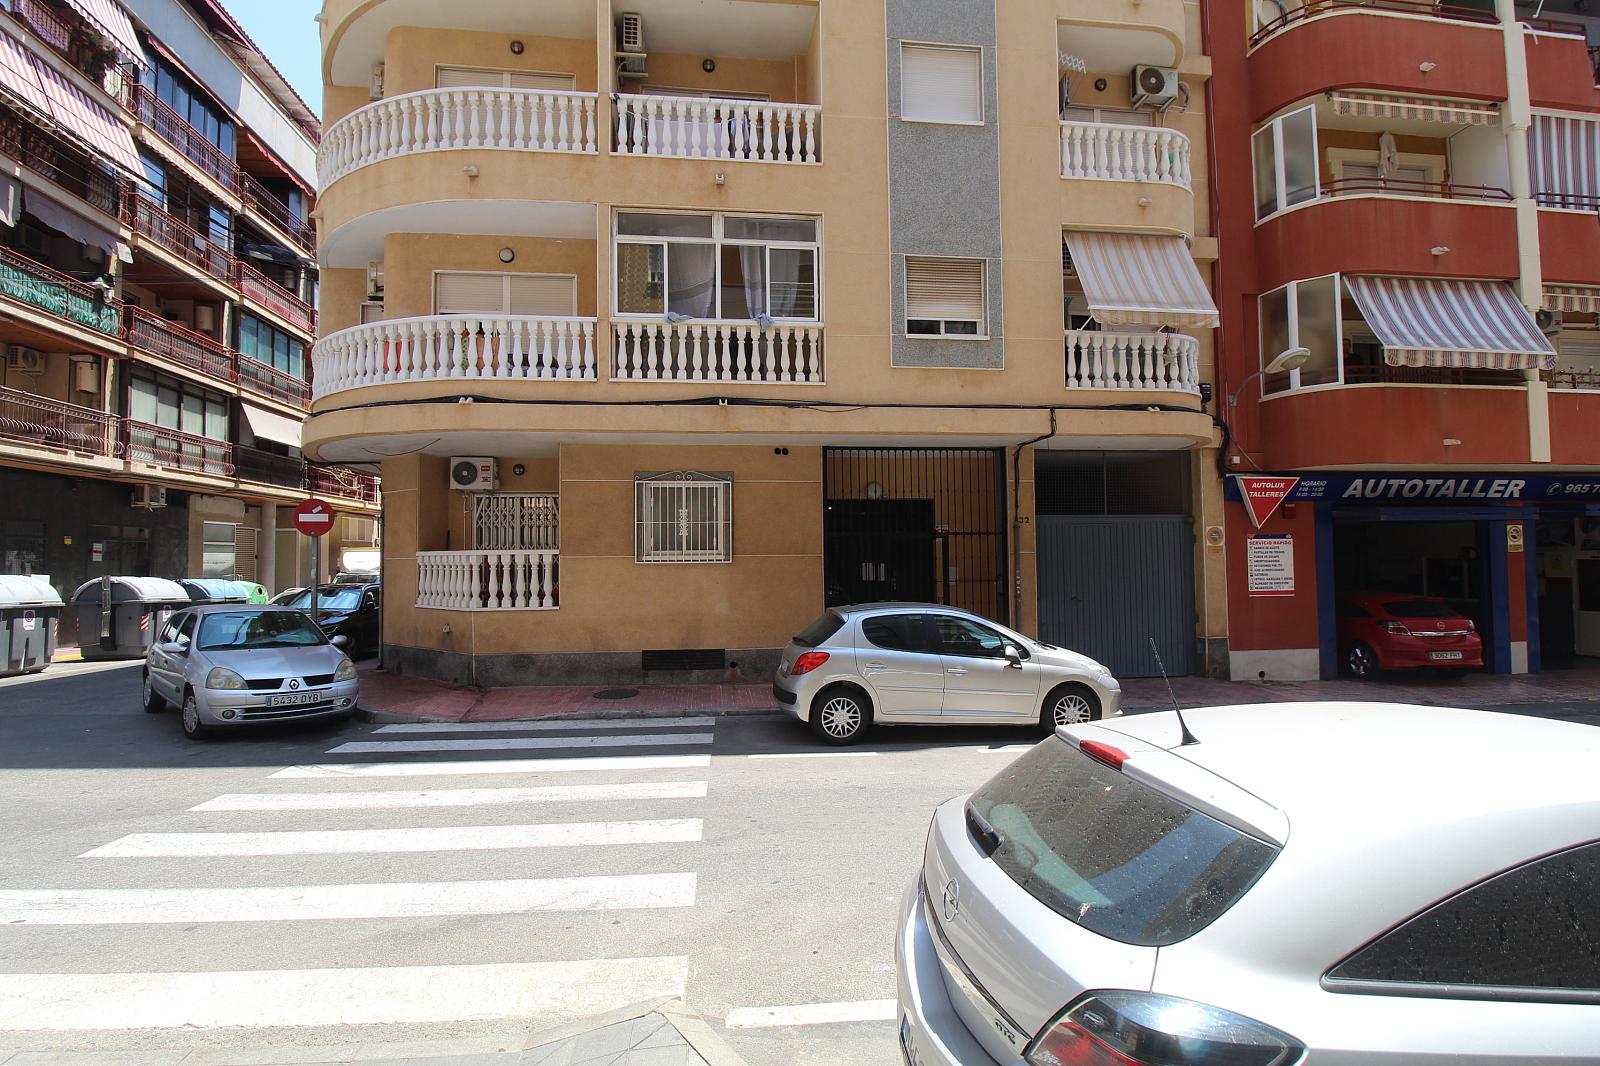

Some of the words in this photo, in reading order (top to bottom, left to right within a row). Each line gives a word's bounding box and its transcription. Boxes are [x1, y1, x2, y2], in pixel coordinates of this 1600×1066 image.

[1341, 479, 1526, 498] AUTOTALLER
[1564, 484, 1591, 493] 965
[273, 696, 298, 705] 5432
[301, 694, 319, 703] DYB
